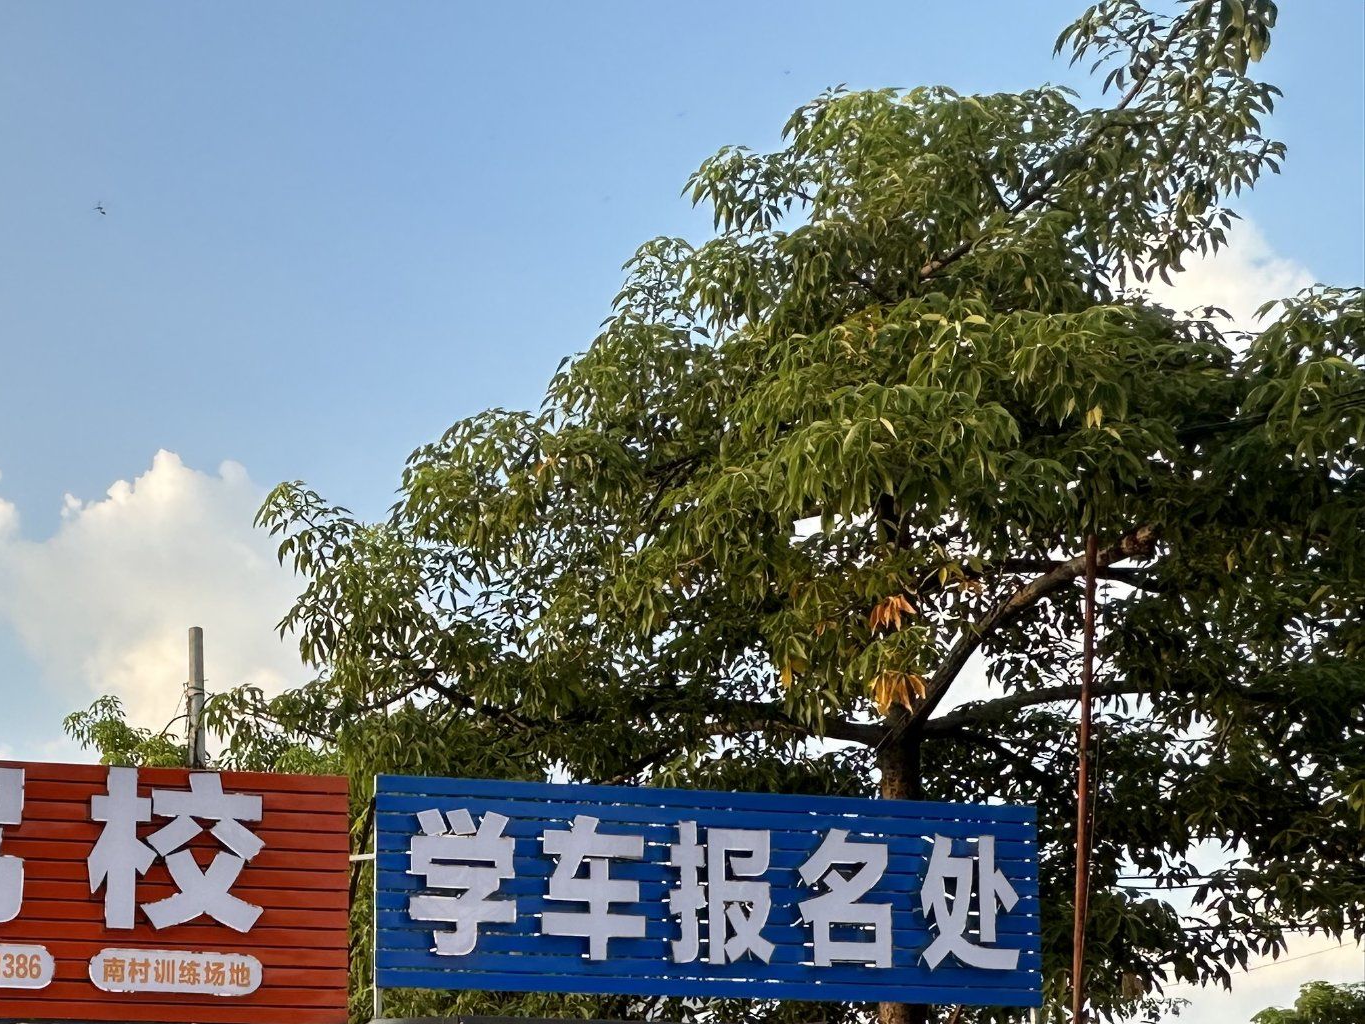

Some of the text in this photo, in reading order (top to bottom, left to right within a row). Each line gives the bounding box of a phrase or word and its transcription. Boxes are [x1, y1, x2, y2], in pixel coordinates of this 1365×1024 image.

[409, 808, 1020, 970] 学车报名处
[103, 956, 251, 988] 南村训练场地
